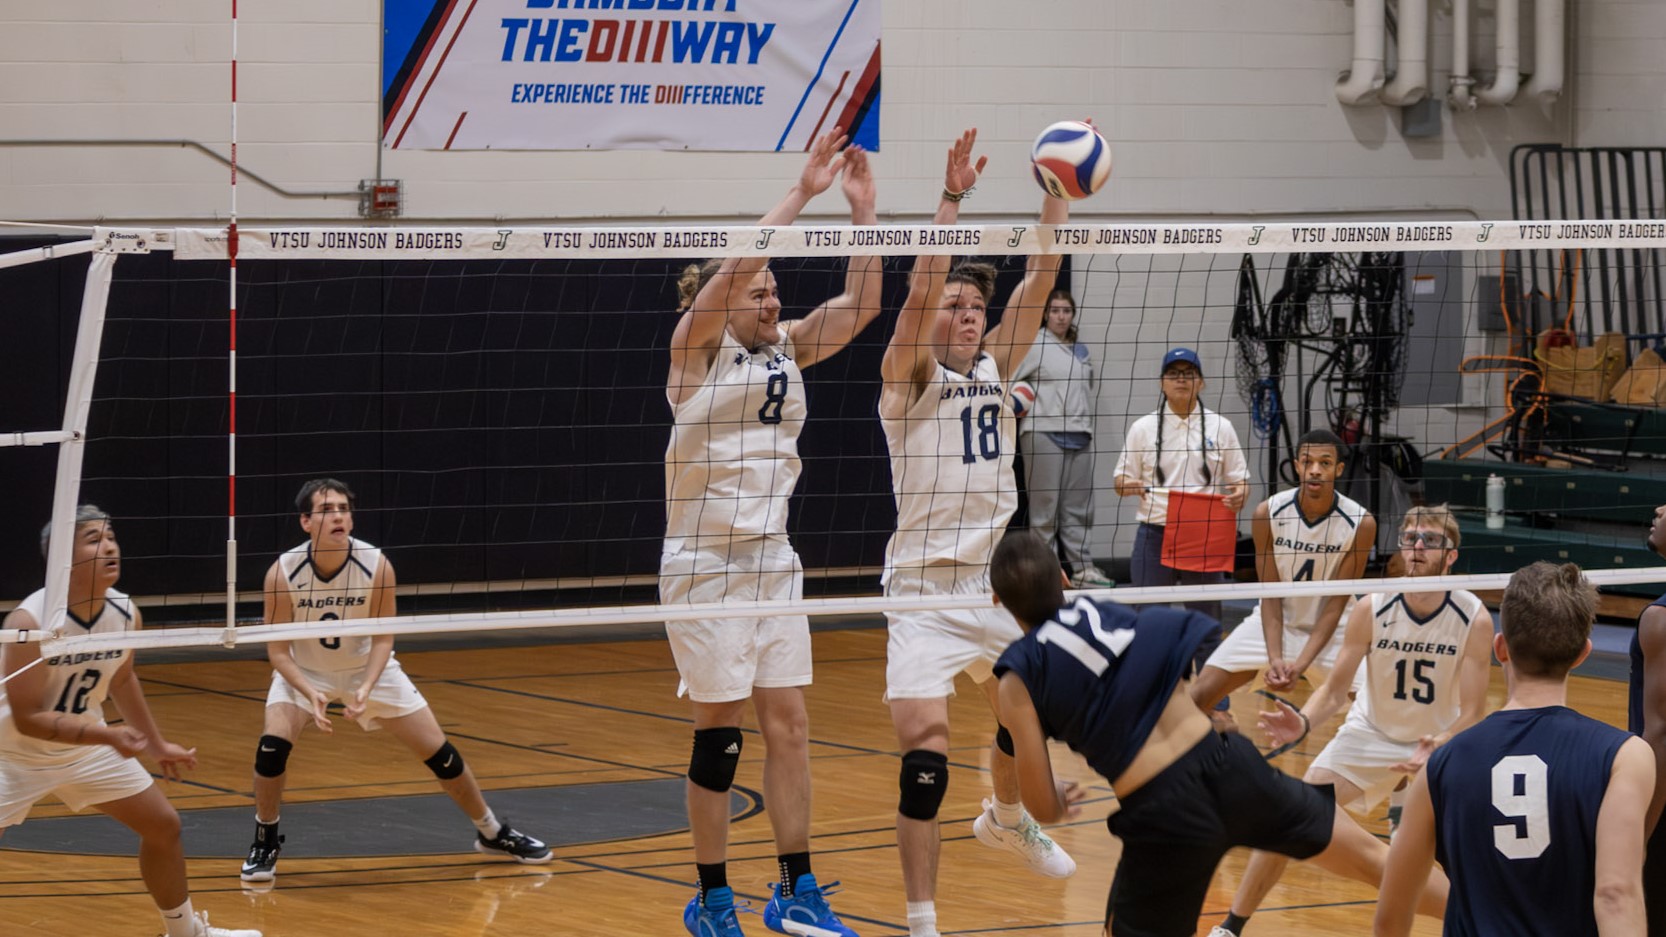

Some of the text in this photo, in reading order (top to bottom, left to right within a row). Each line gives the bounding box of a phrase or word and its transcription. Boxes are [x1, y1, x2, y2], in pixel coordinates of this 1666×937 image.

[511, 84, 765, 105] EXPERIENCE THE DIIIFFERENCE
[270, 232, 463, 249] VTSU JOHNSON BADGERS
[492, 230, 512, 251] J
[543, 232, 728, 248] VTSU JOHNSON BADGERS
[756, 229, 775, 249] J
[804, 230, 980, 247] VTSU JOHNSON BADGERS
[1007, 227, 1026, 247] J
[1054, 229, 1222, 245] VTSU JOHNSON BADGERS
[1248, 226, 1265, 245] J
[1292, 226, 1452, 243] VTSU JOHNSON BADGERS
[1477, 224, 1493, 242] J
[1519, 224, 1666, 240] VTSU JOHNSON BADGER
[758, 371, 788, 425] 8
[961, 404, 1000, 464] 18
[1036, 597, 1136, 678] 12
[1377, 639, 1457, 656] BADGERS
[54, 668, 102, 714] 12
[1393, 659, 1436, 705] 15
[1491, 755, 1551, 860] 9
